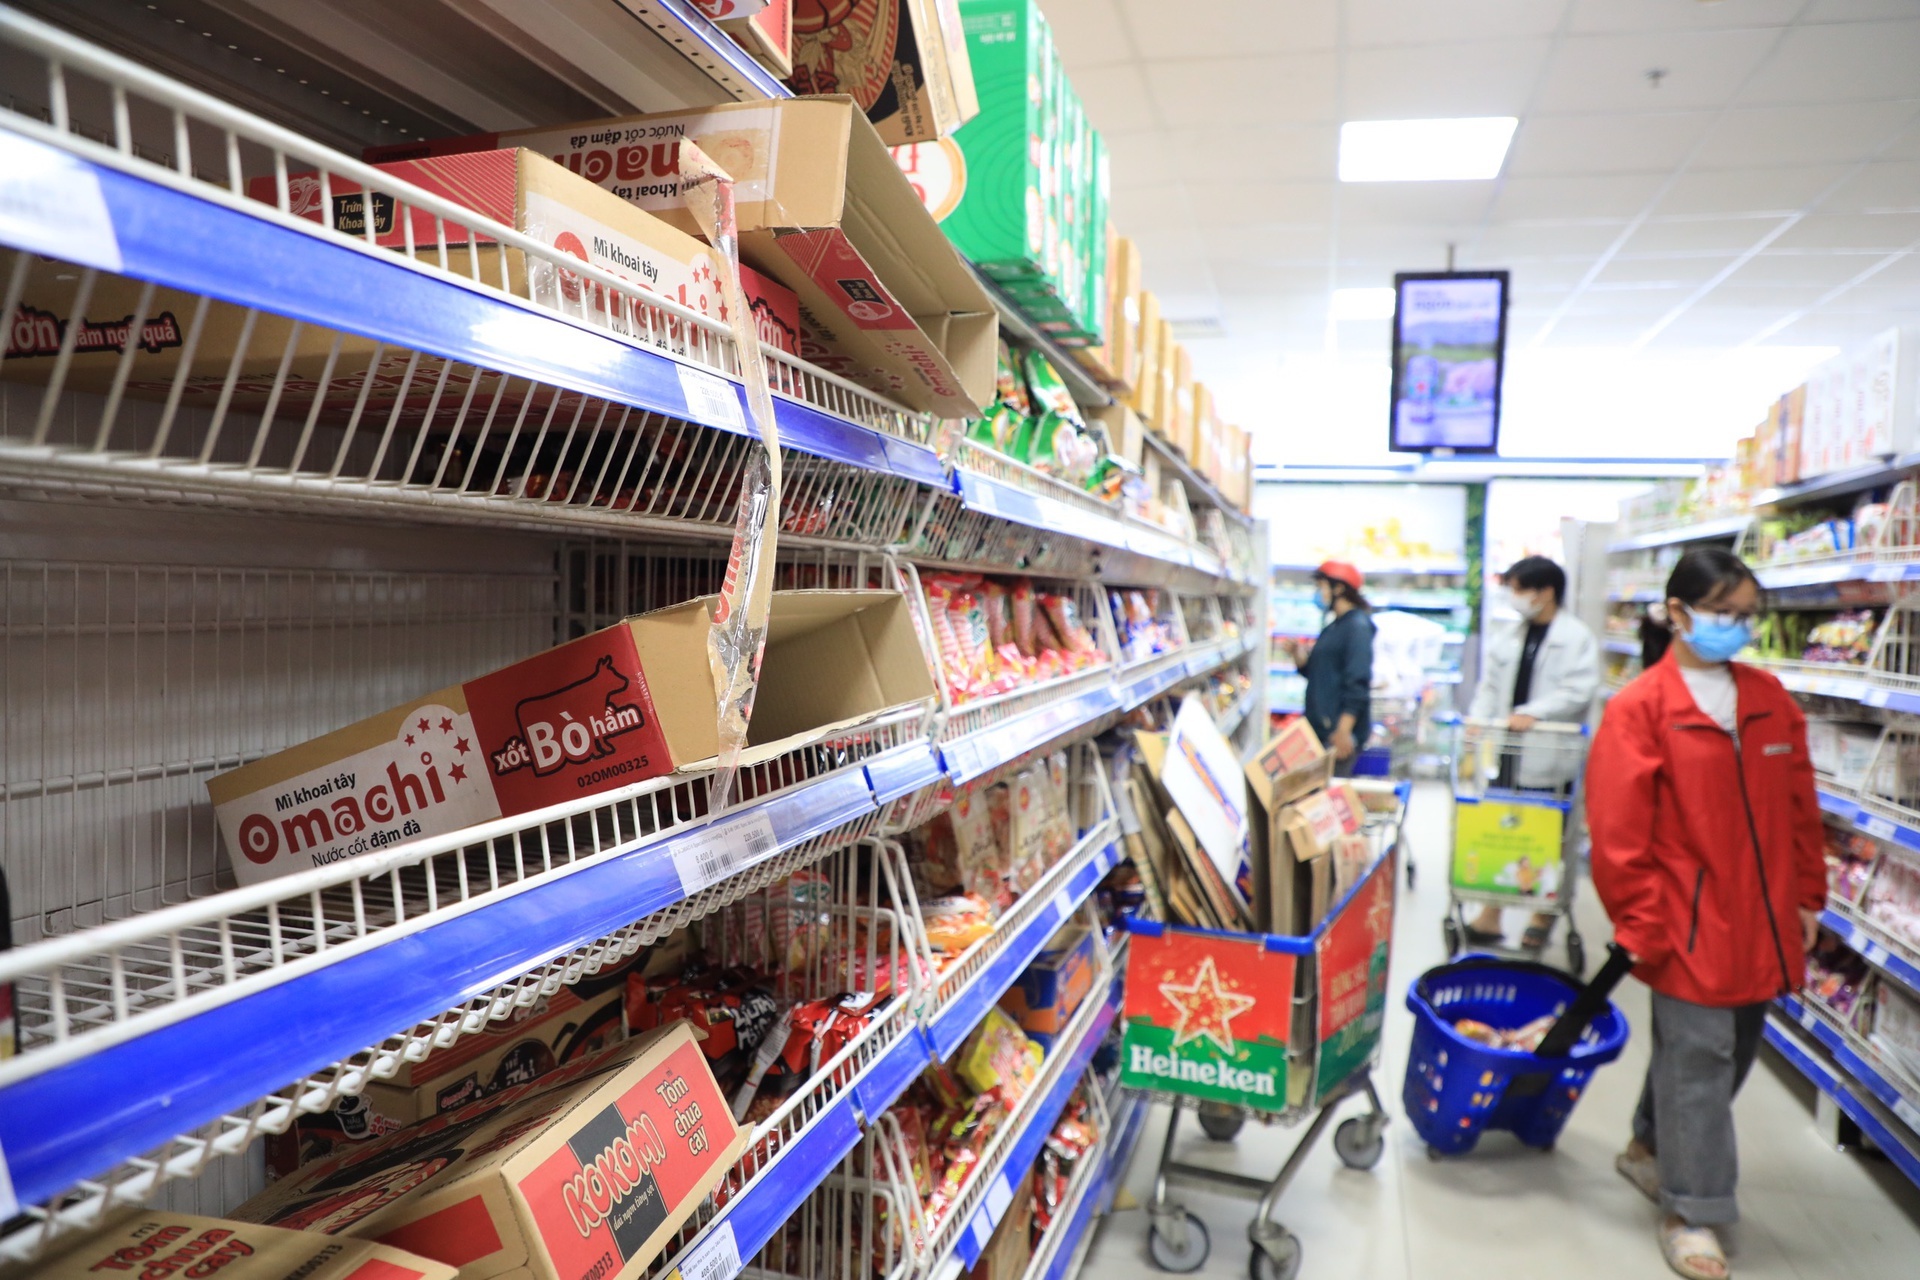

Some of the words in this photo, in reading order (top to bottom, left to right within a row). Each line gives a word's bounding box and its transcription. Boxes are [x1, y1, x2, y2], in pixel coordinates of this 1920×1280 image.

[570, 135, 588, 149] đà
[590, 128, 622, 147] đậm
[625, 128, 646, 144] cốt
[654, 124, 685, 142] Nước
[635, 183, 677, 200] khoai
[594, 236, 609, 259] Mì
[611, 242, 641, 273] khoai
[643, 261, 659, 284] tây
[494, 738, 531, 772] xốt
[527, 710, 591, 769] Bò
[589, 706, 640, 738] hầm
[239, 751, 447, 865] Omachi
[275, 792, 294, 812] Mì
[294, 778, 333, 807] khoai
[333, 772, 356, 790] tây
[311, 845, 346, 868] Nước
[347, 836, 370, 857] cốt
[370, 827, 402, 849] đậm
[402, 818, 422, 837] đà
[1130, 1043, 1277, 1097] Heineken
[656, 1075, 690, 1109] Tôm
[674, 1101, 703, 1138] chua
[687, 1125, 710, 1157] cay
[562, 1113, 667, 1239] KOKOMI
[88, 1225, 192, 1273] Tôm
[138, 1228, 236, 1280] chua
[183, 1237, 255, 1280] cay
